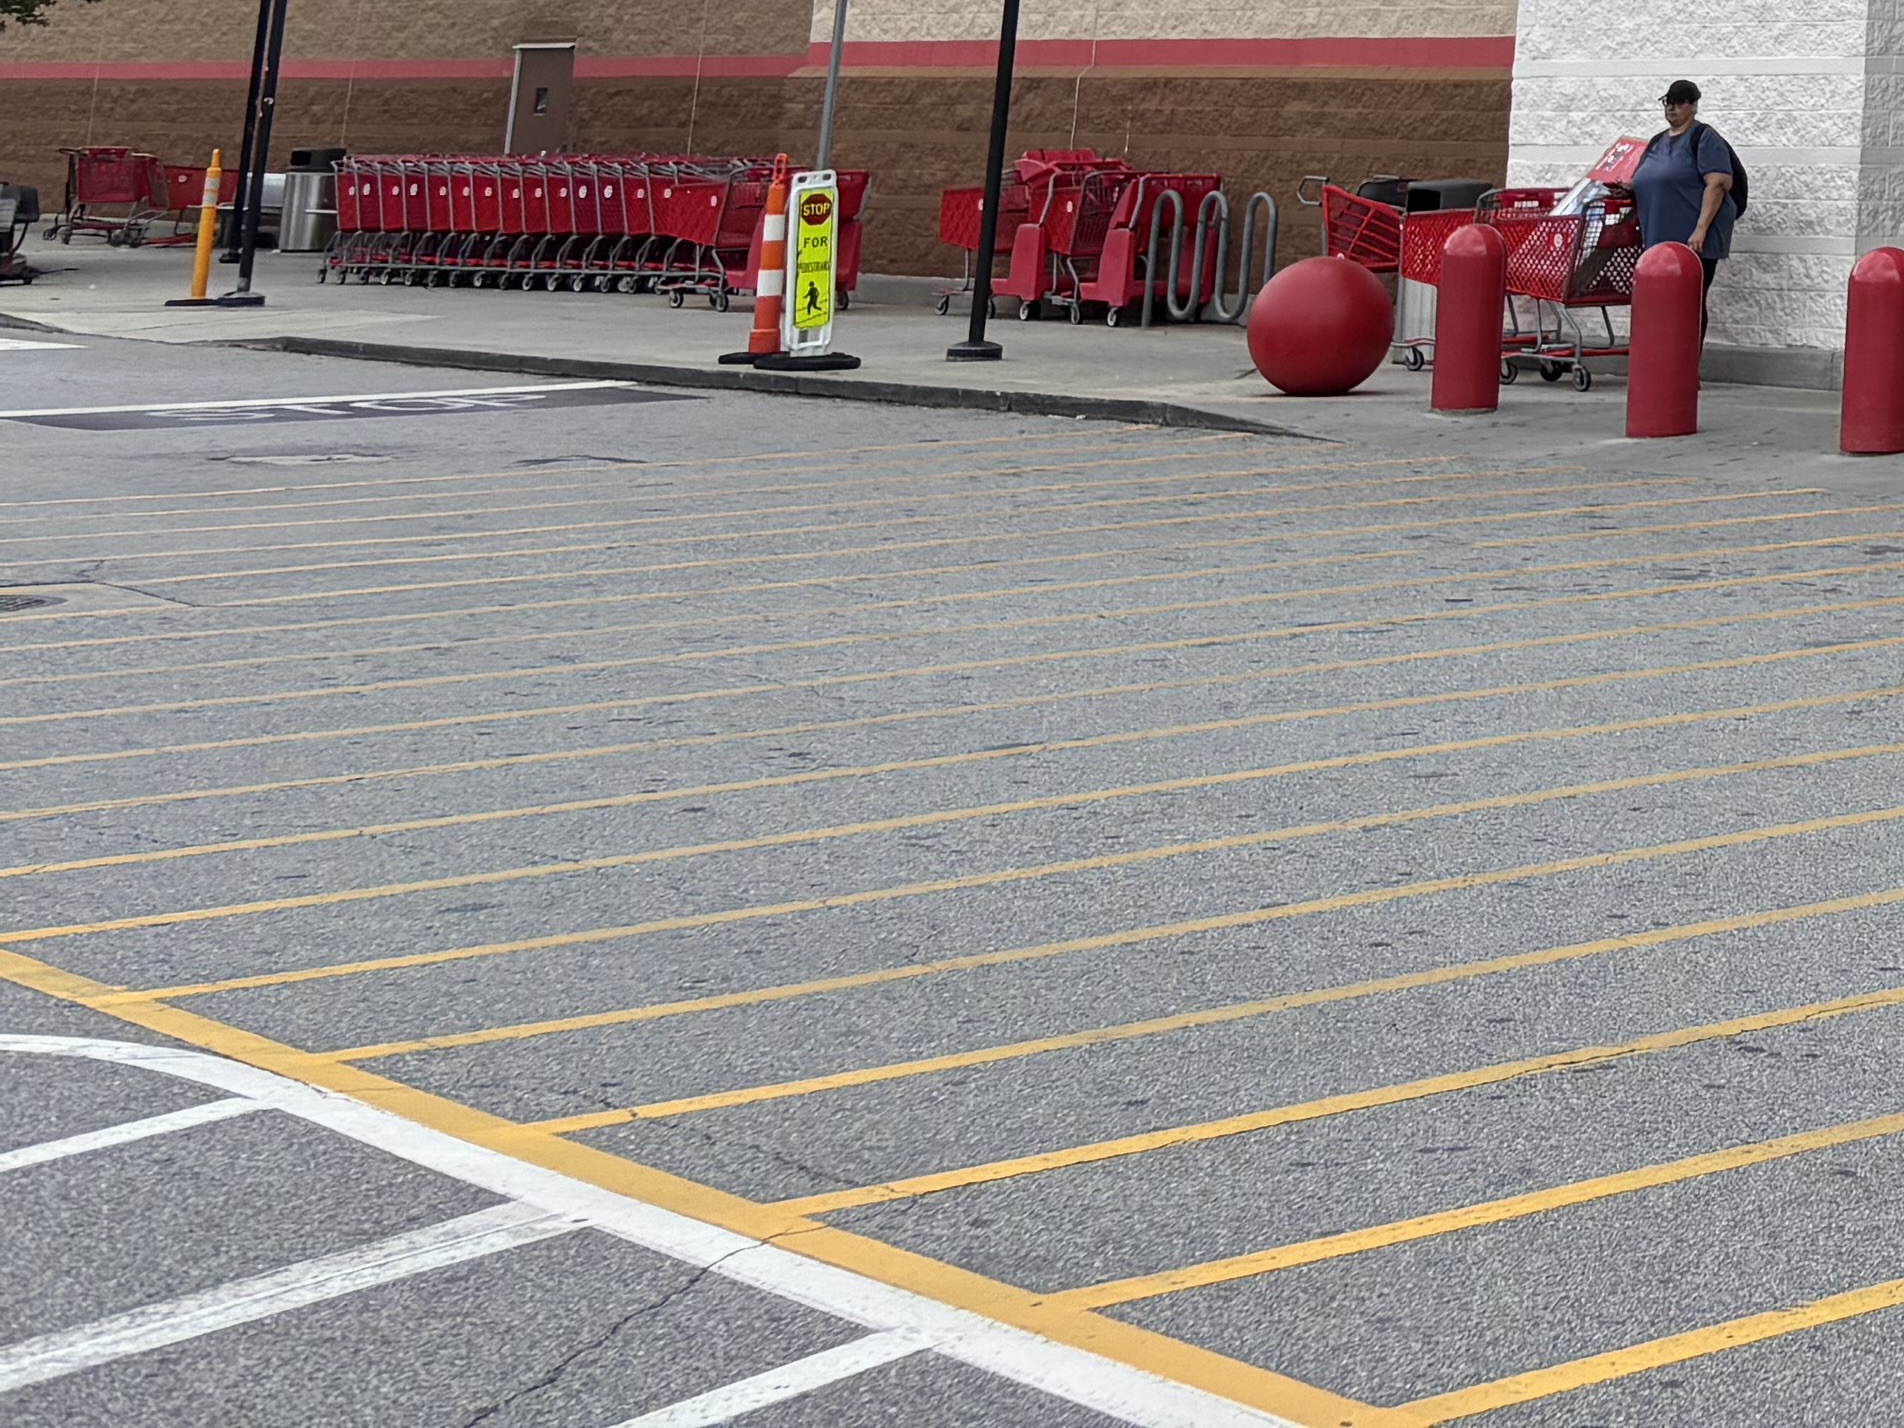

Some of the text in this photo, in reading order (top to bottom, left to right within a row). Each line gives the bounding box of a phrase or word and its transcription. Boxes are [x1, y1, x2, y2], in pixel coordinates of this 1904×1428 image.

[803, 203, 831, 217] STOP
[803, 236, 828, 248] FOR
[146, 394, 546, 420] STOP
